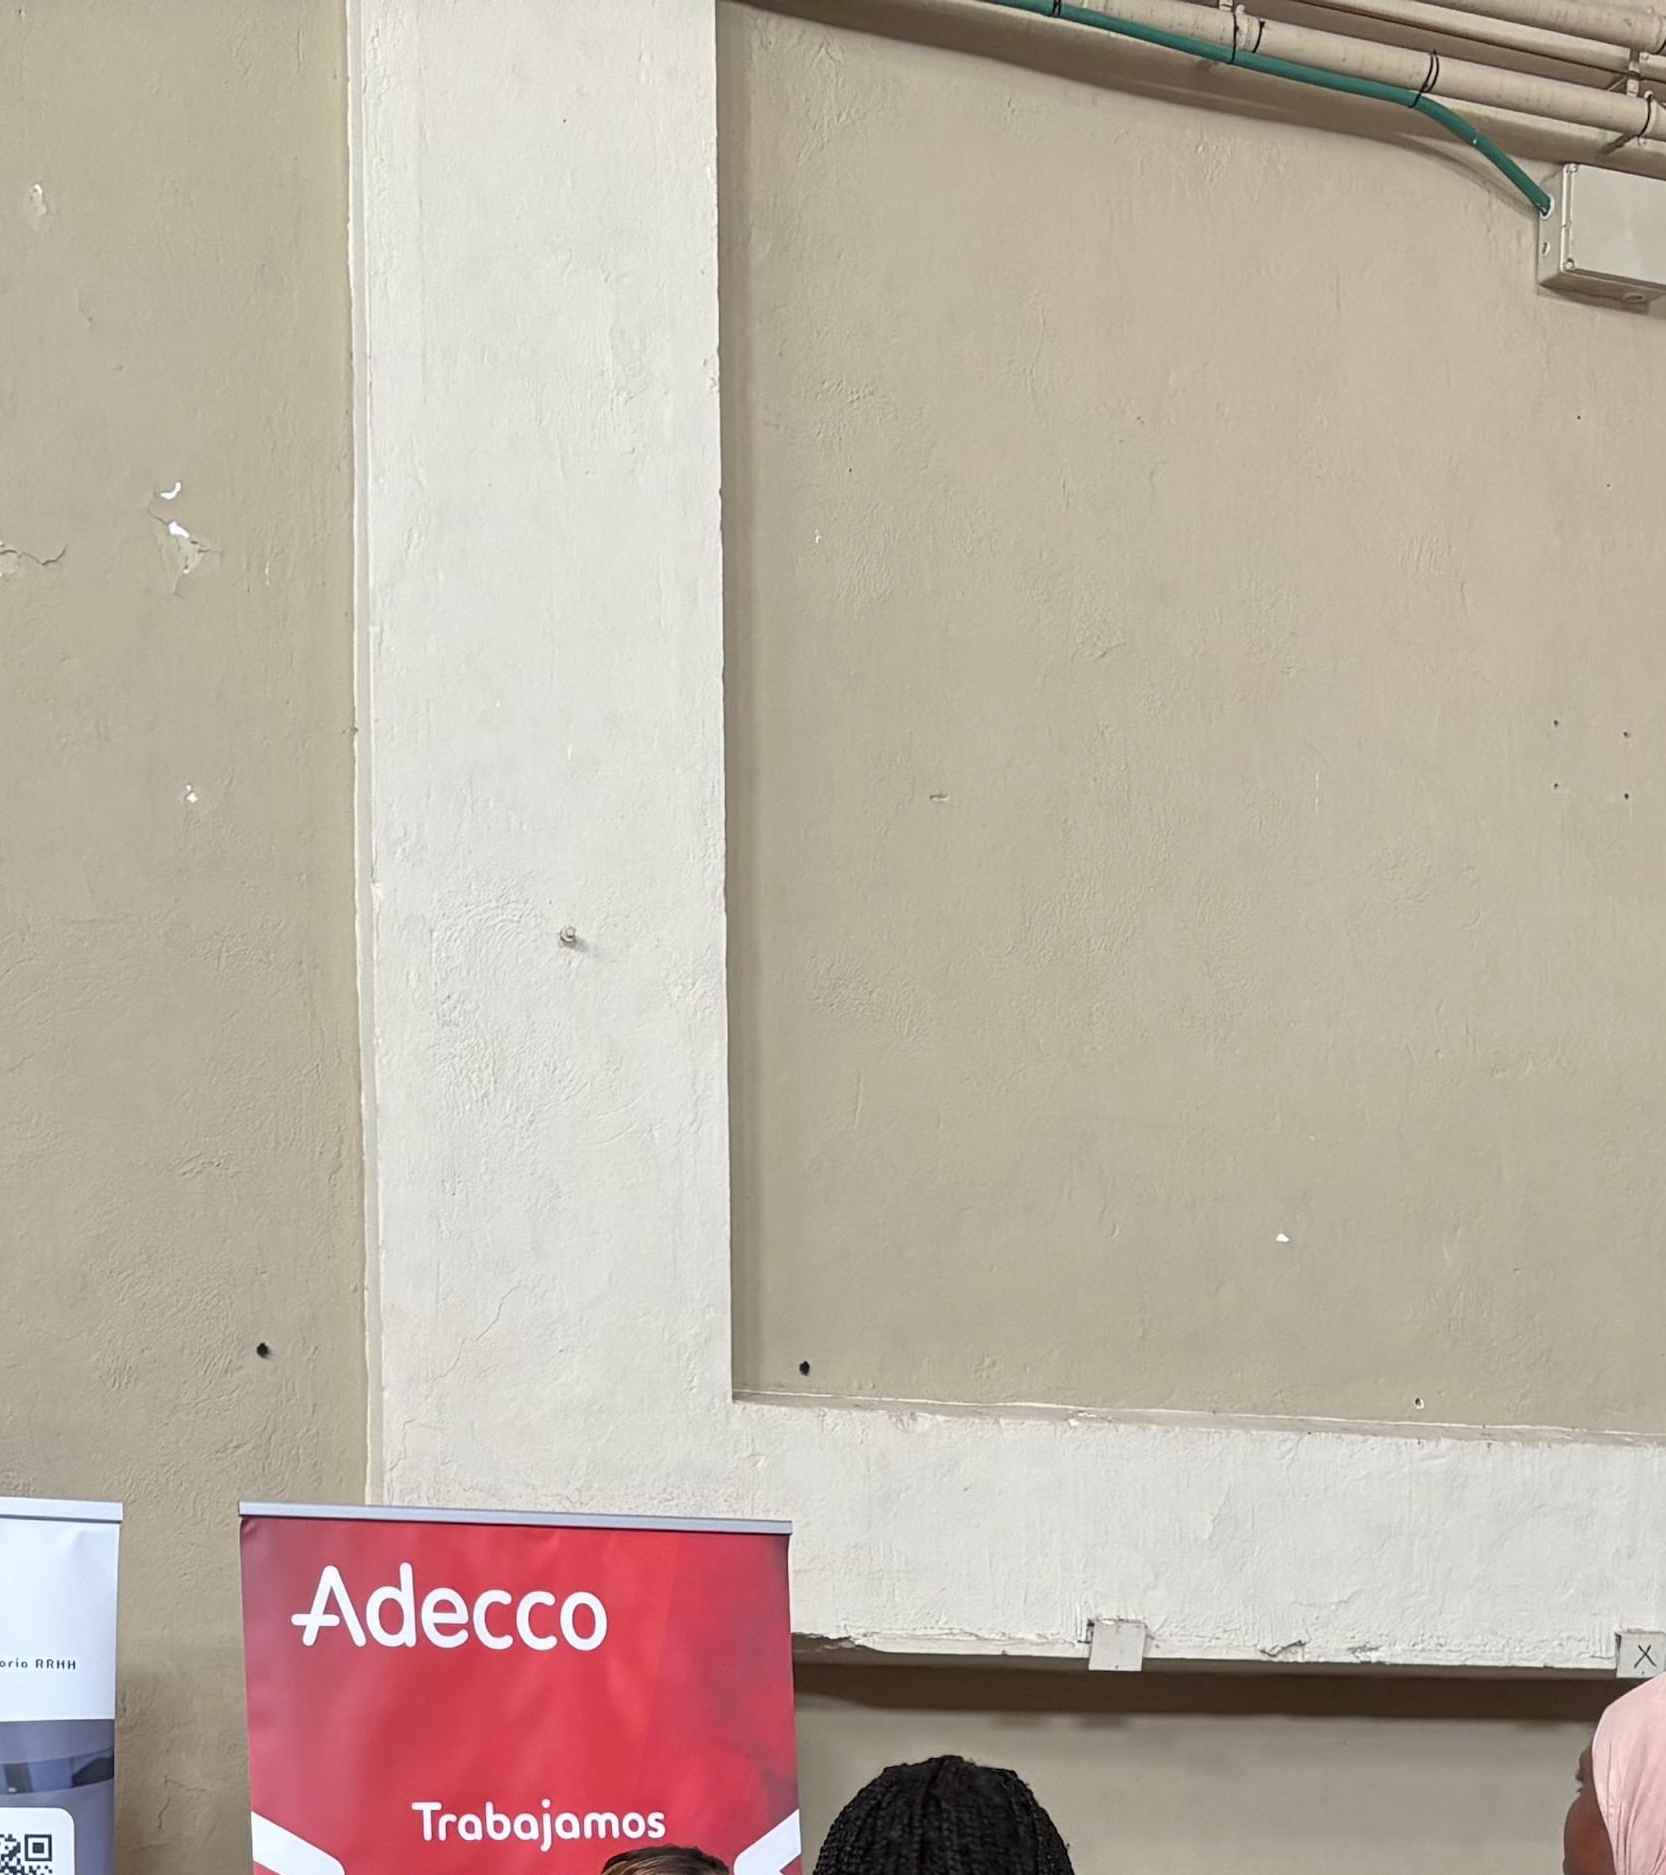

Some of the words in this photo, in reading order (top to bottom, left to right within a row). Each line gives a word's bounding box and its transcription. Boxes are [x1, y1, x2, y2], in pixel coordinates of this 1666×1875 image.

[291, 1562, 608, 1651] Adecco
[35, 1658, 77, 1671] RRHH
[411, 1798, 667, 1852] Trabajamos
